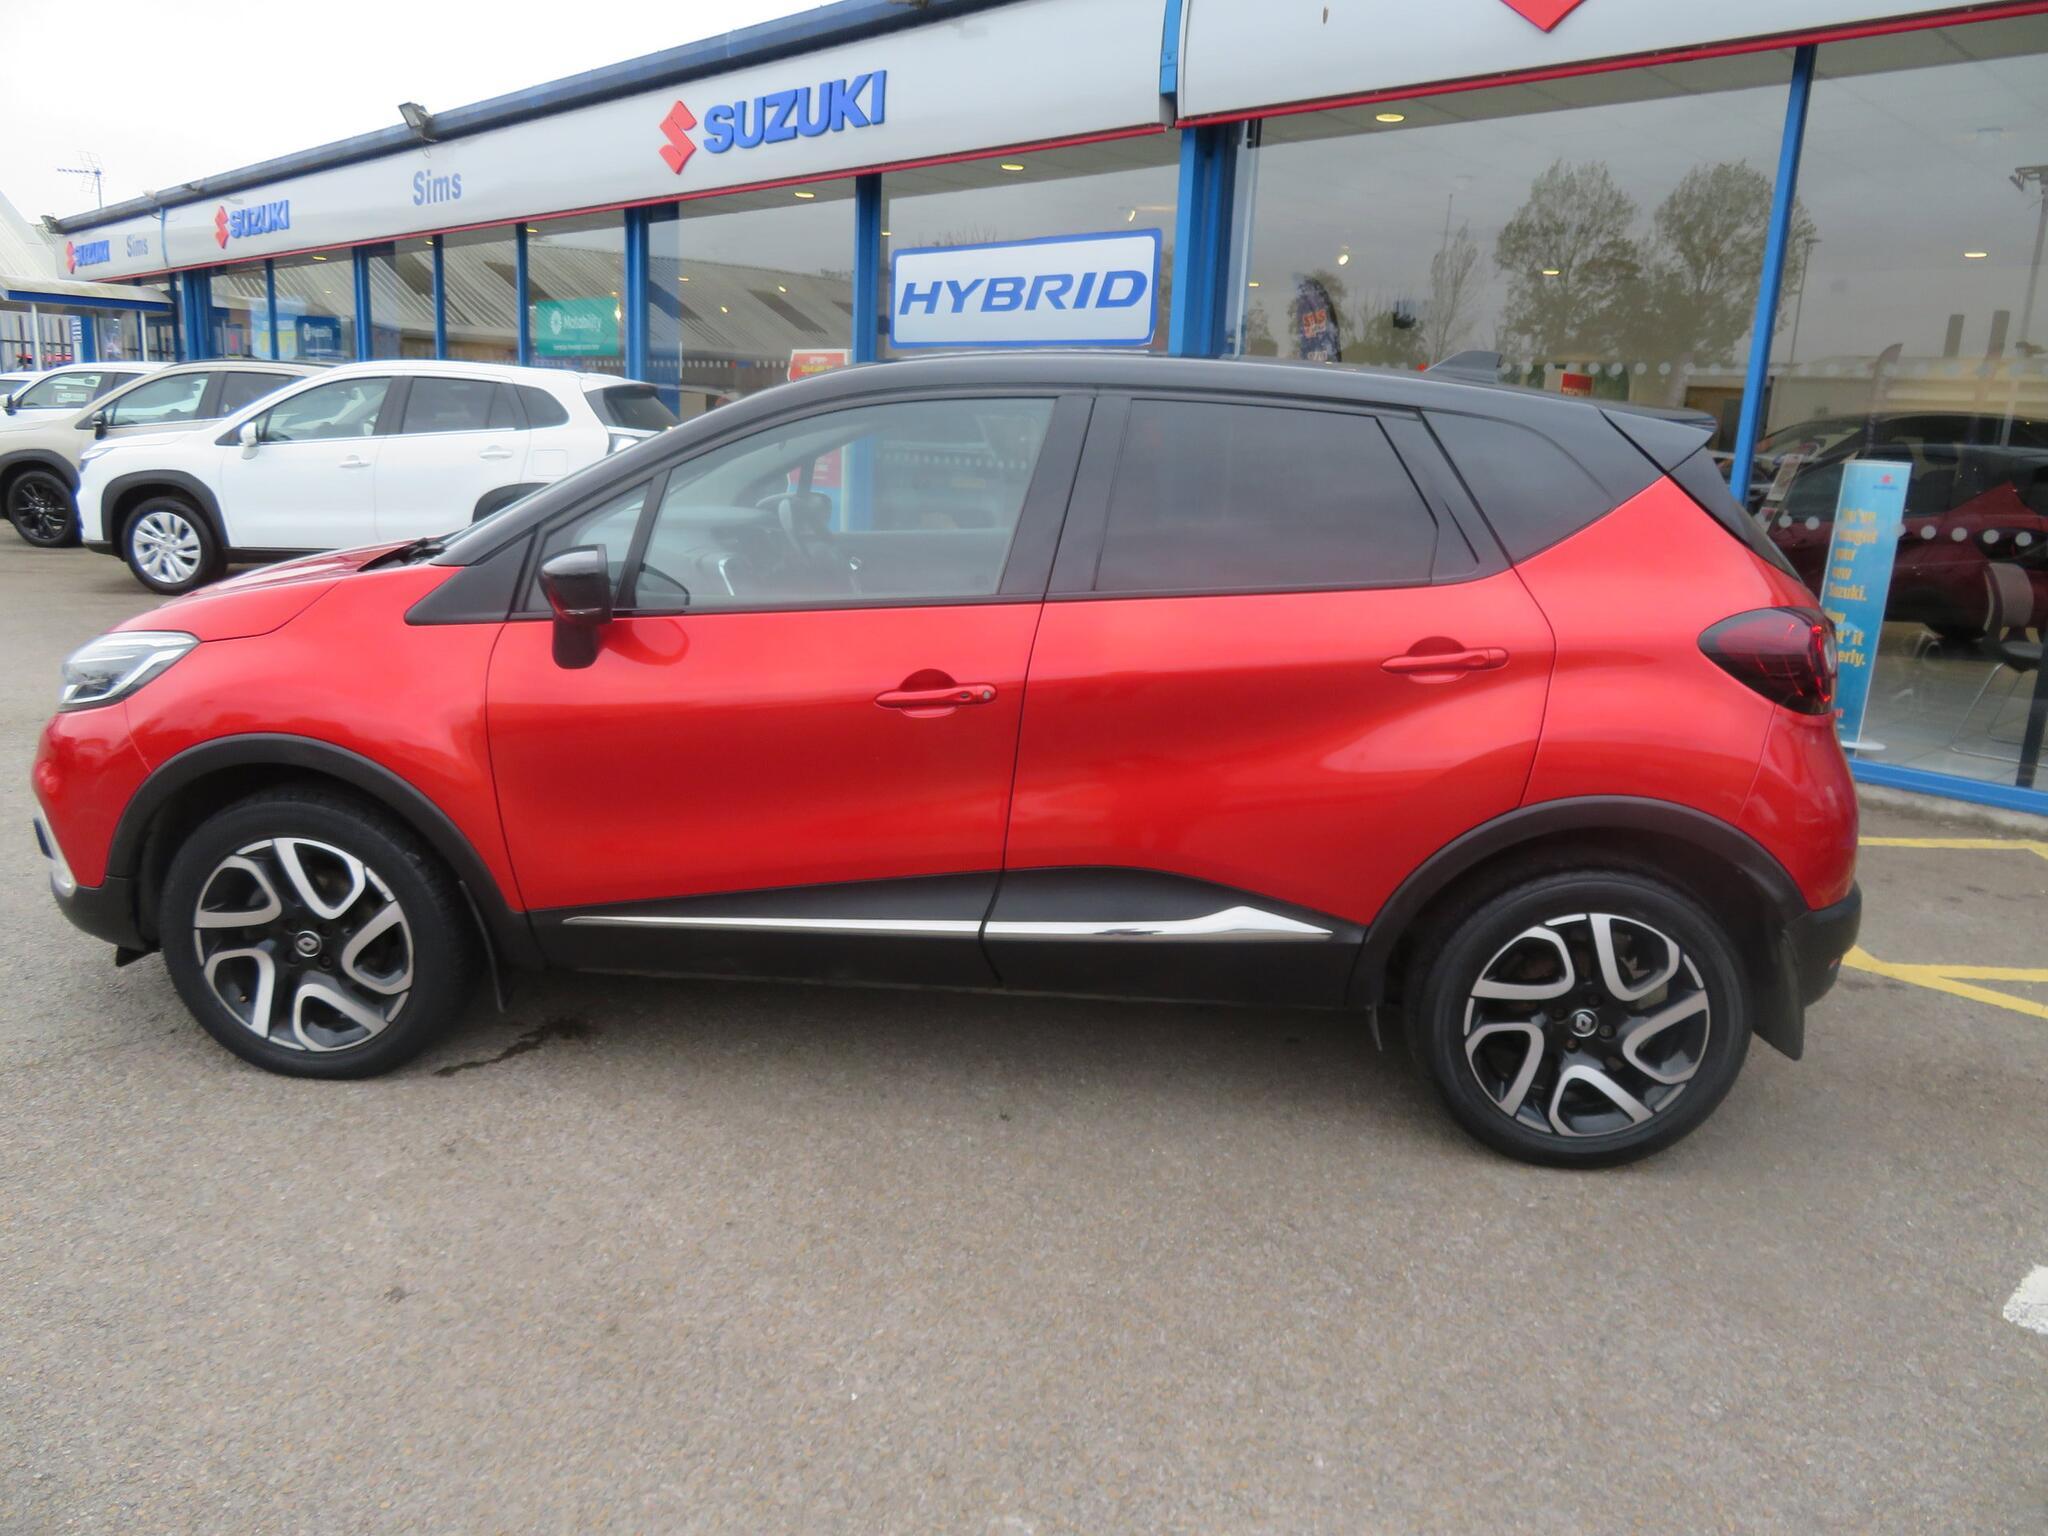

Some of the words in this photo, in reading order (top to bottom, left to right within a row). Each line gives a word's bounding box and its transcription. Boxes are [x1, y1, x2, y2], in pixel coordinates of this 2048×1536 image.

[703, 70, 887, 154] SUZUKI
[413, 169, 462, 206] Sims
[230, 200, 290, 239] SUZUKI
[75, 240, 110, 267] SUZUKI
[127, 234, 149, 258] Sims
[899, 270, 1148, 315] HYBRID
